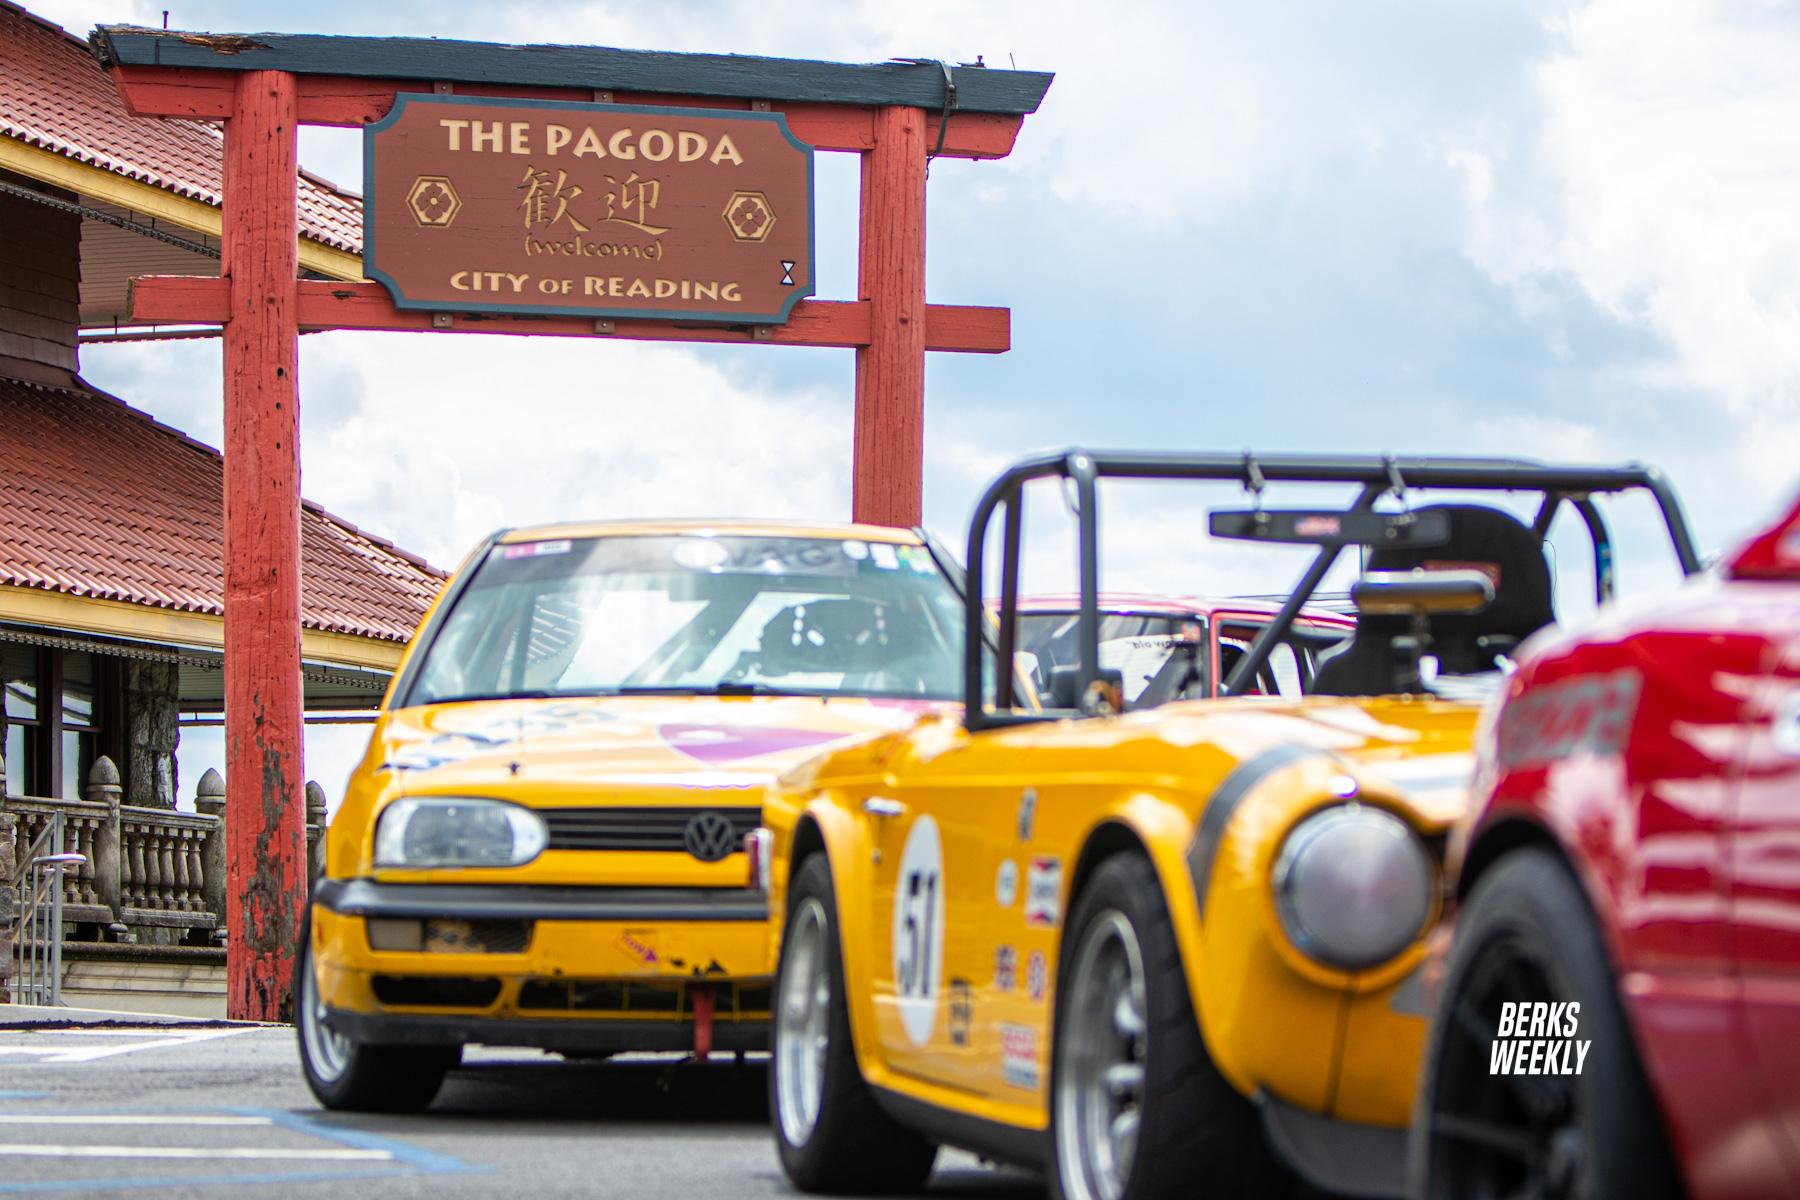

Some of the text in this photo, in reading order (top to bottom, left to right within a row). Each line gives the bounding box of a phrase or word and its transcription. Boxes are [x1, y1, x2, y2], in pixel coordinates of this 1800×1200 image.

[440, 118, 744, 166] THE PAGODA
[525, 233, 663, 261] (welcome)
[450, 270, 742, 302] CITY OF READING
[899, 872, 937, 997] 51
